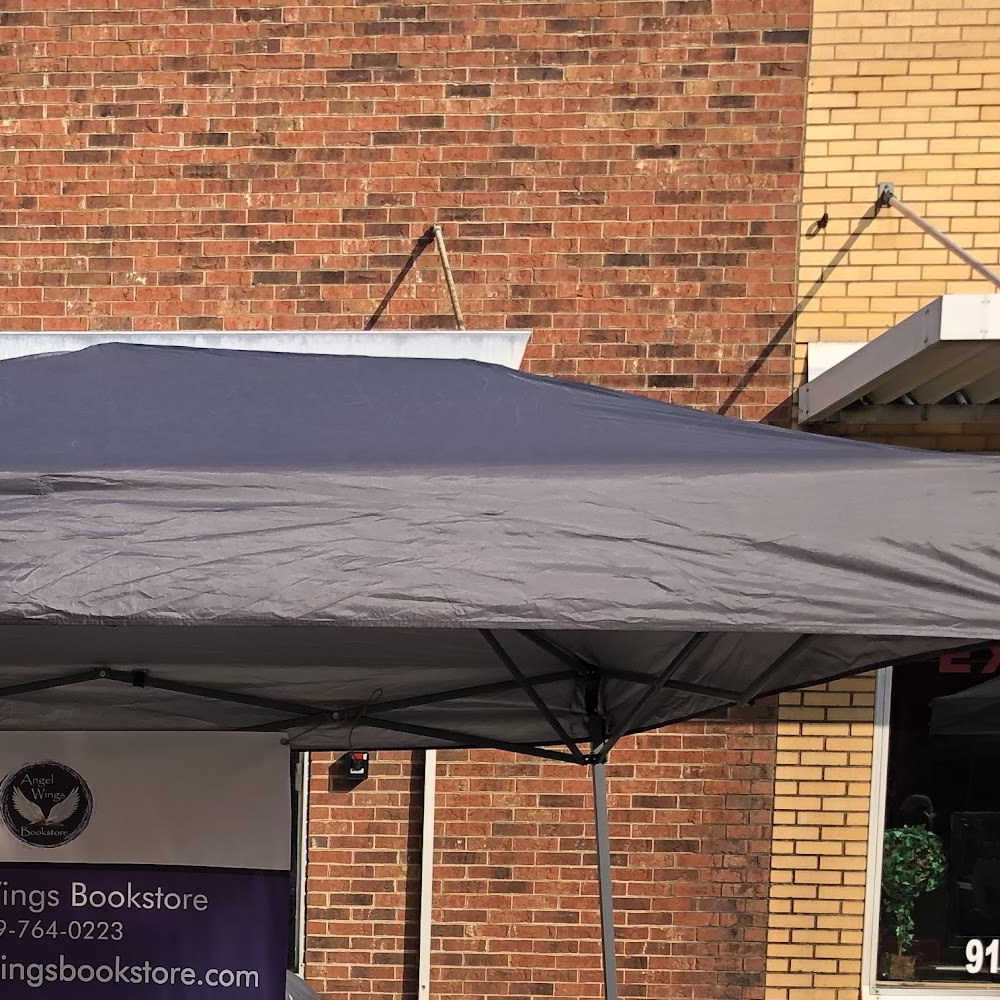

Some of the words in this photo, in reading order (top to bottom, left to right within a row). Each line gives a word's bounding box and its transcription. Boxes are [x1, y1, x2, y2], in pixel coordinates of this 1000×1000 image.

[21, 774, 54, 787] Angel
[32, 788, 65, 802] Wings
[21, 826, 68, 836] Bookstore
[71, 884, 209, 911] Bookstore
